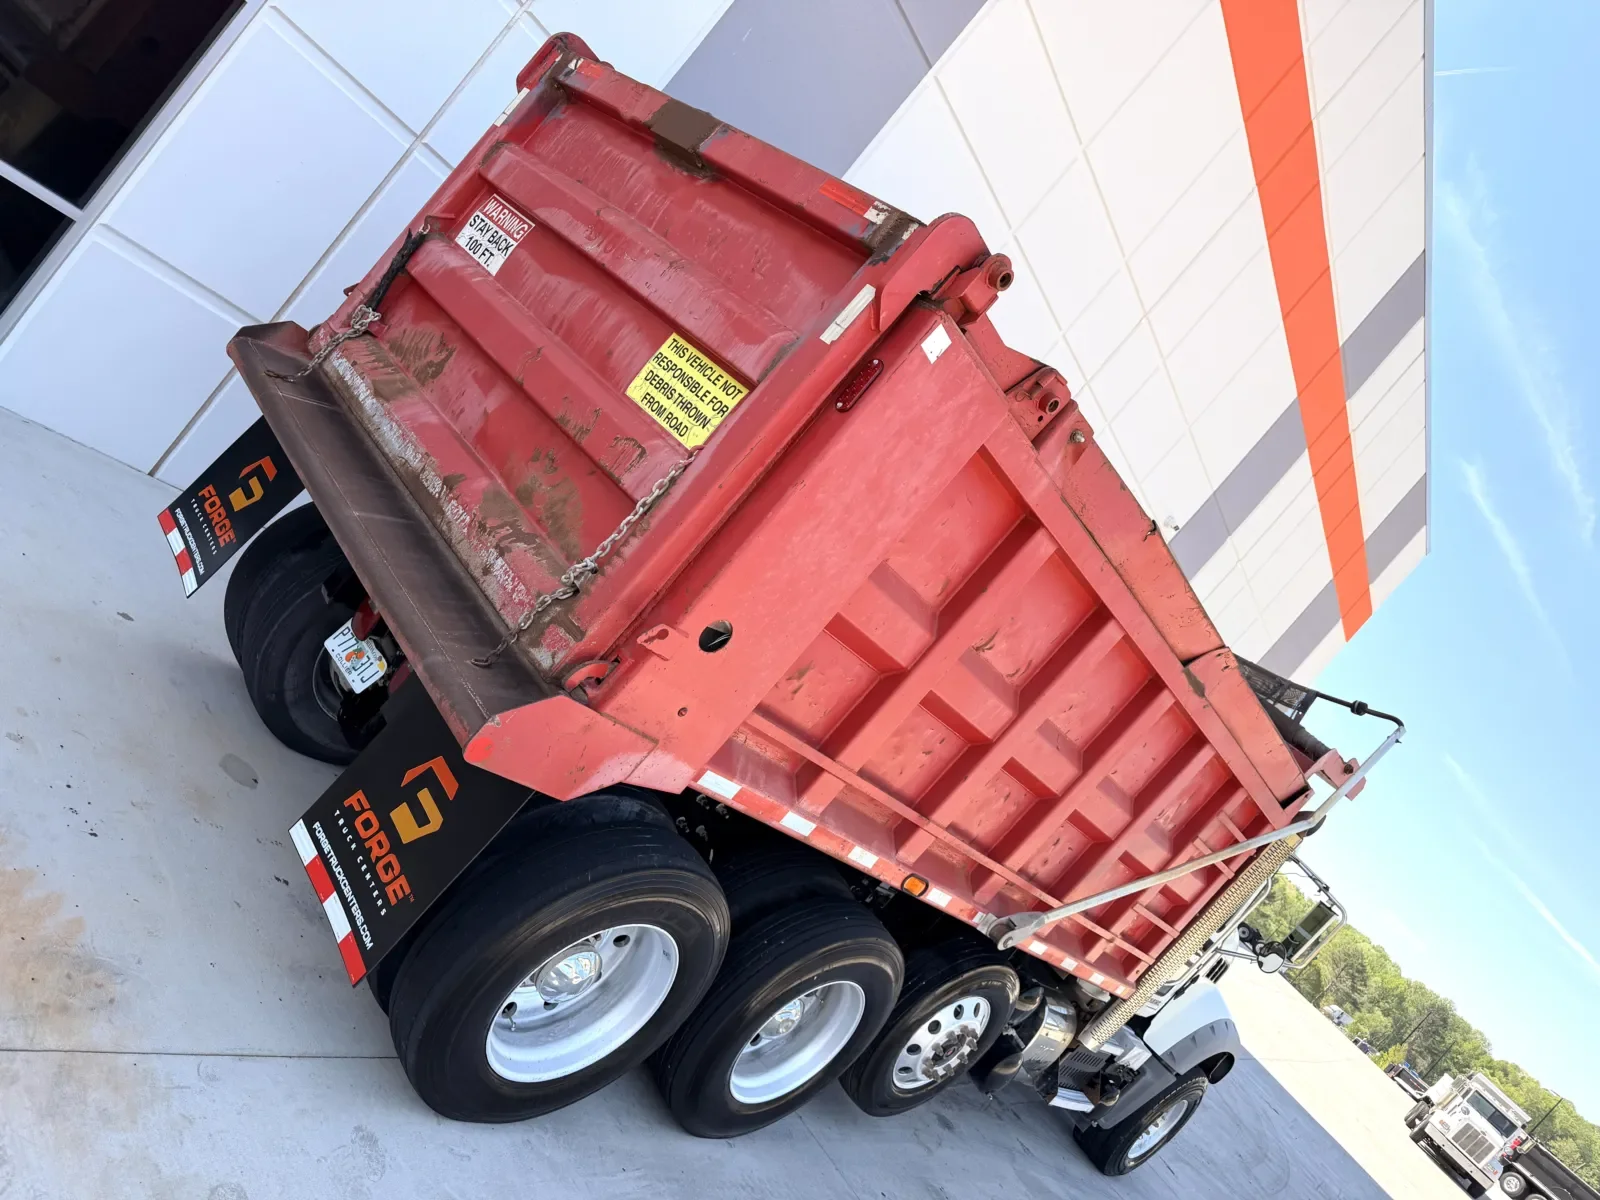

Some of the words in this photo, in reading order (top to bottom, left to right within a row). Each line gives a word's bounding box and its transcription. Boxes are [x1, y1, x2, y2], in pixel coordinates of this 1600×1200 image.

[469, 214, 493, 238] STAY
[487, 230, 514, 257] BACK
[482, 198, 529, 240] WARNING
[465, 236, 483, 255] 100
[478, 248, 495, 267] FT.
[644, 369, 677, 400] DEBRIS
[672, 393, 711, 430] THROWN
[652, 352, 712, 403] RESPONSIBLE
[706, 396, 730, 418] FOR
[667, 338, 689, 359] THIS
[685, 352, 724, 386] VEHICLE
[719, 380, 743, 400] NOT
[640, 392, 667, 419] FROM
[662, 411, 689, 438] ROAD
[174, 507, 206, 576] FORGETRUCKCENTERS.COM
[198, 484, 234, 548] FORGE
[335, 652, 353, 676] COLLIER
[334, 809, 357, 852] TRUCK
[357, 855, 387, 916] CENTERS
[343, 789, 412, 907] FORGE
[312, 821, 374, 951] FORGETRUCKCENTERS.COM
